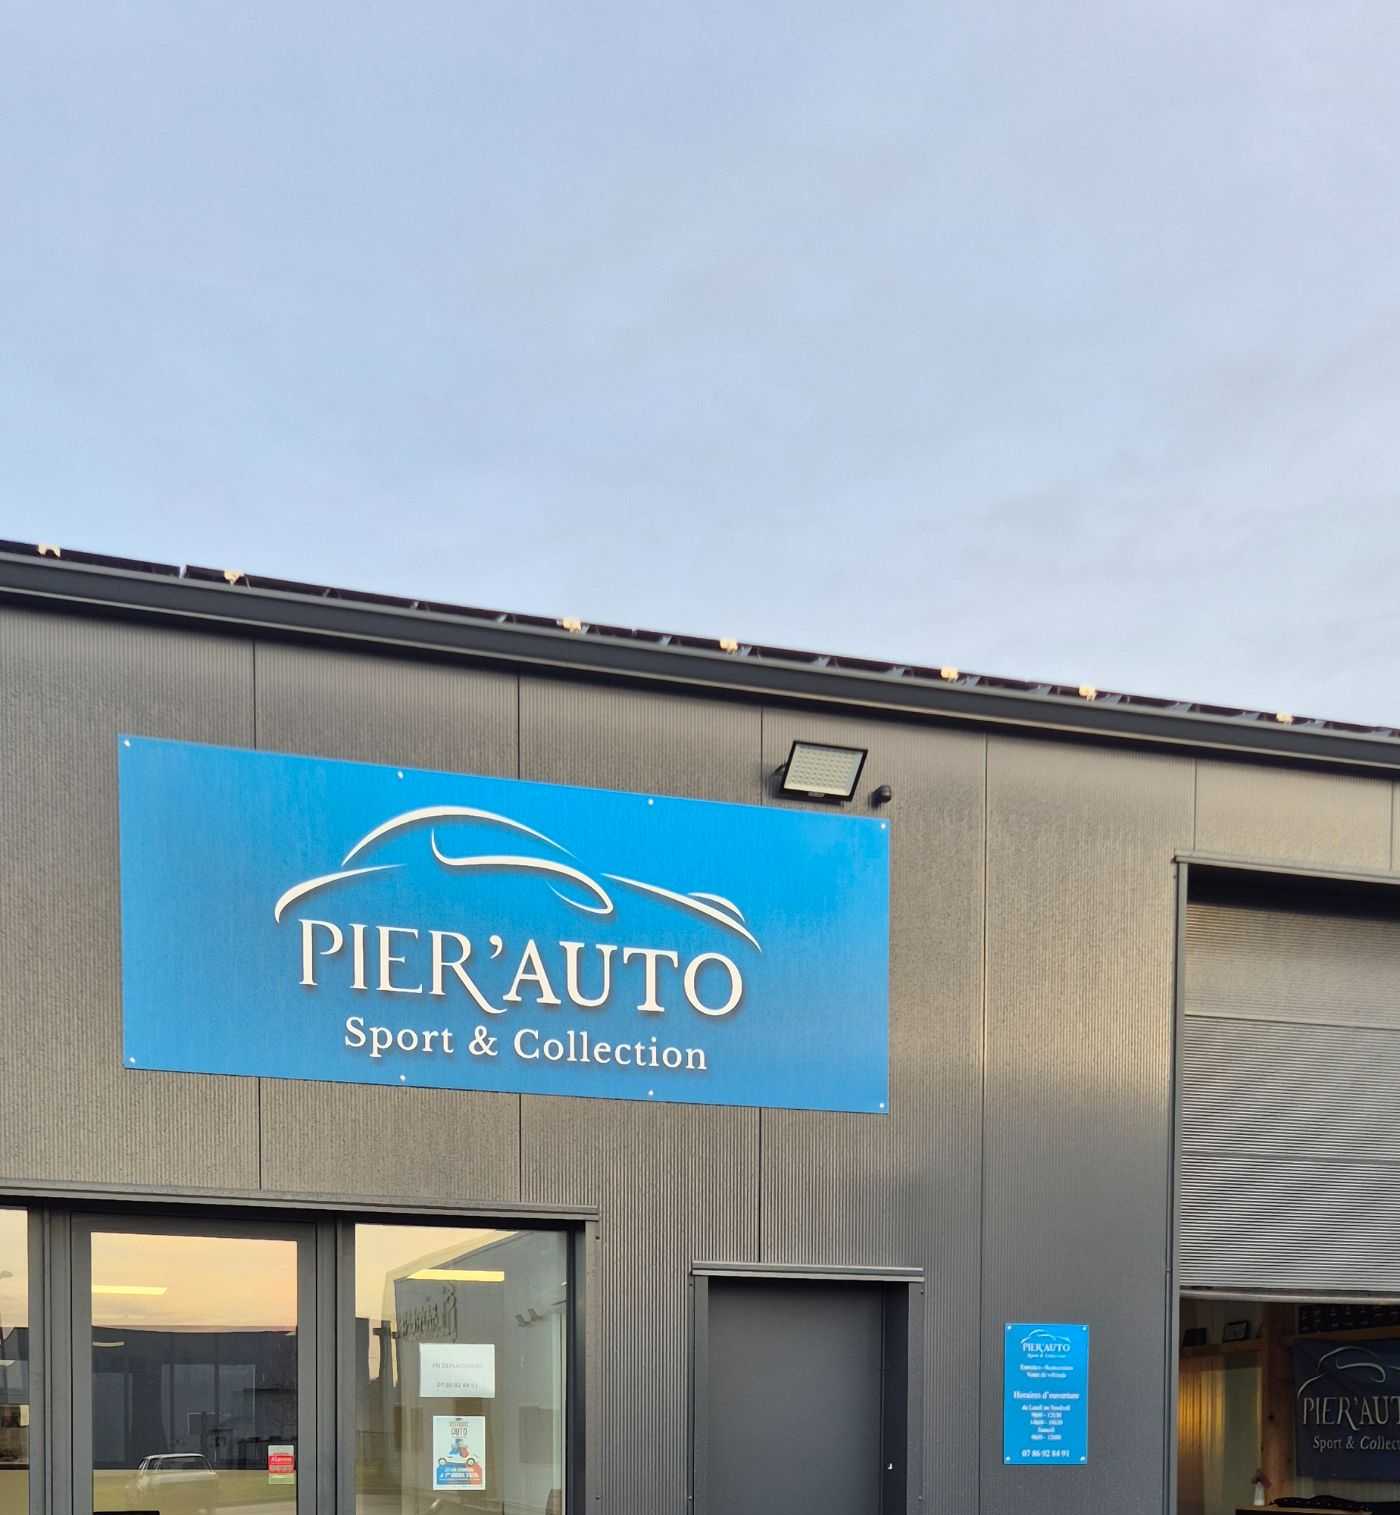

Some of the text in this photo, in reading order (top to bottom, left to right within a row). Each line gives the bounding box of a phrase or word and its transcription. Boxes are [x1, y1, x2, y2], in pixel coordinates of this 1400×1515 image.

[299, 918, 744, 1017] PIER'AUTO
[344, 1017, 708, 1071] Sport & Collection
[1313, 1436, 1341, 1452] Sport
[1346, 1436, 1354, 1449] &
